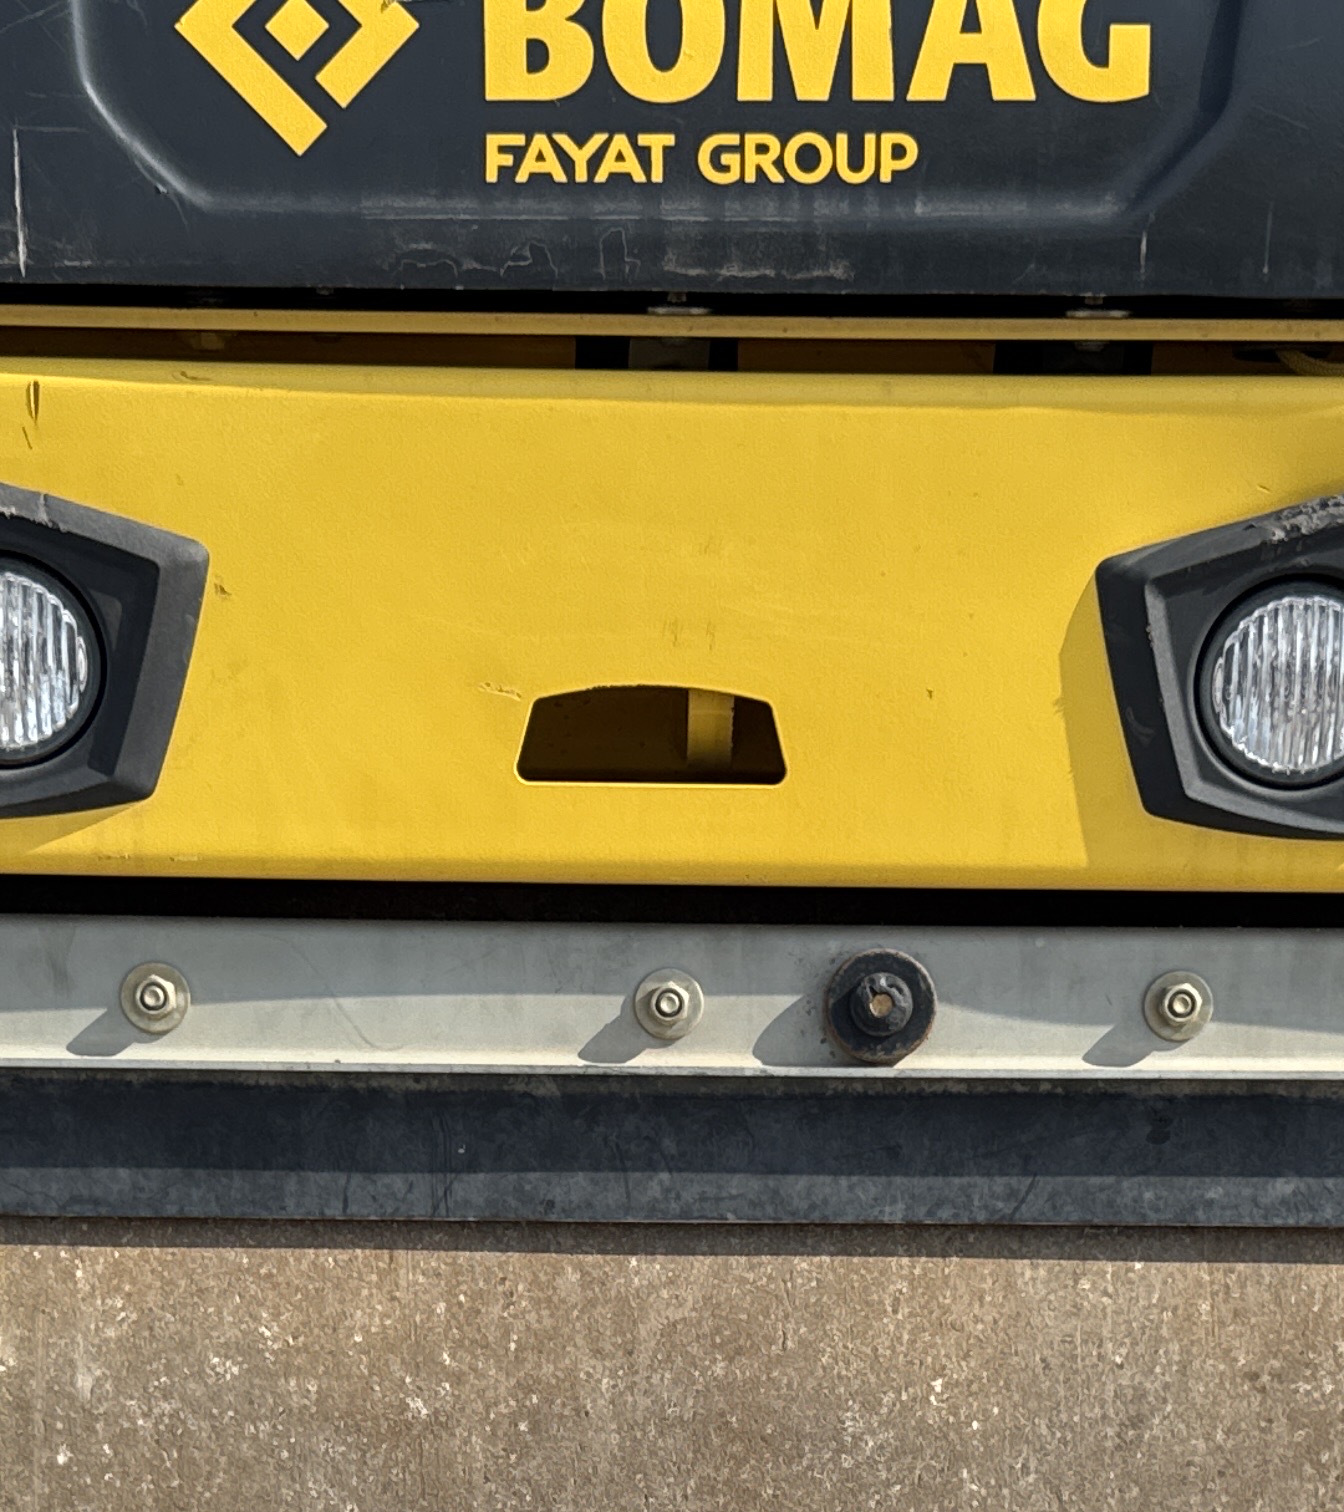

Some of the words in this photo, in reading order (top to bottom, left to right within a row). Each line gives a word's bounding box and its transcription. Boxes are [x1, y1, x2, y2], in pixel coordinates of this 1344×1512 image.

[483, 0, 1152, 104] BOMAG
[484, 132, 676, 184] FAYAT
[697, 131, 919, 185] GROUP
